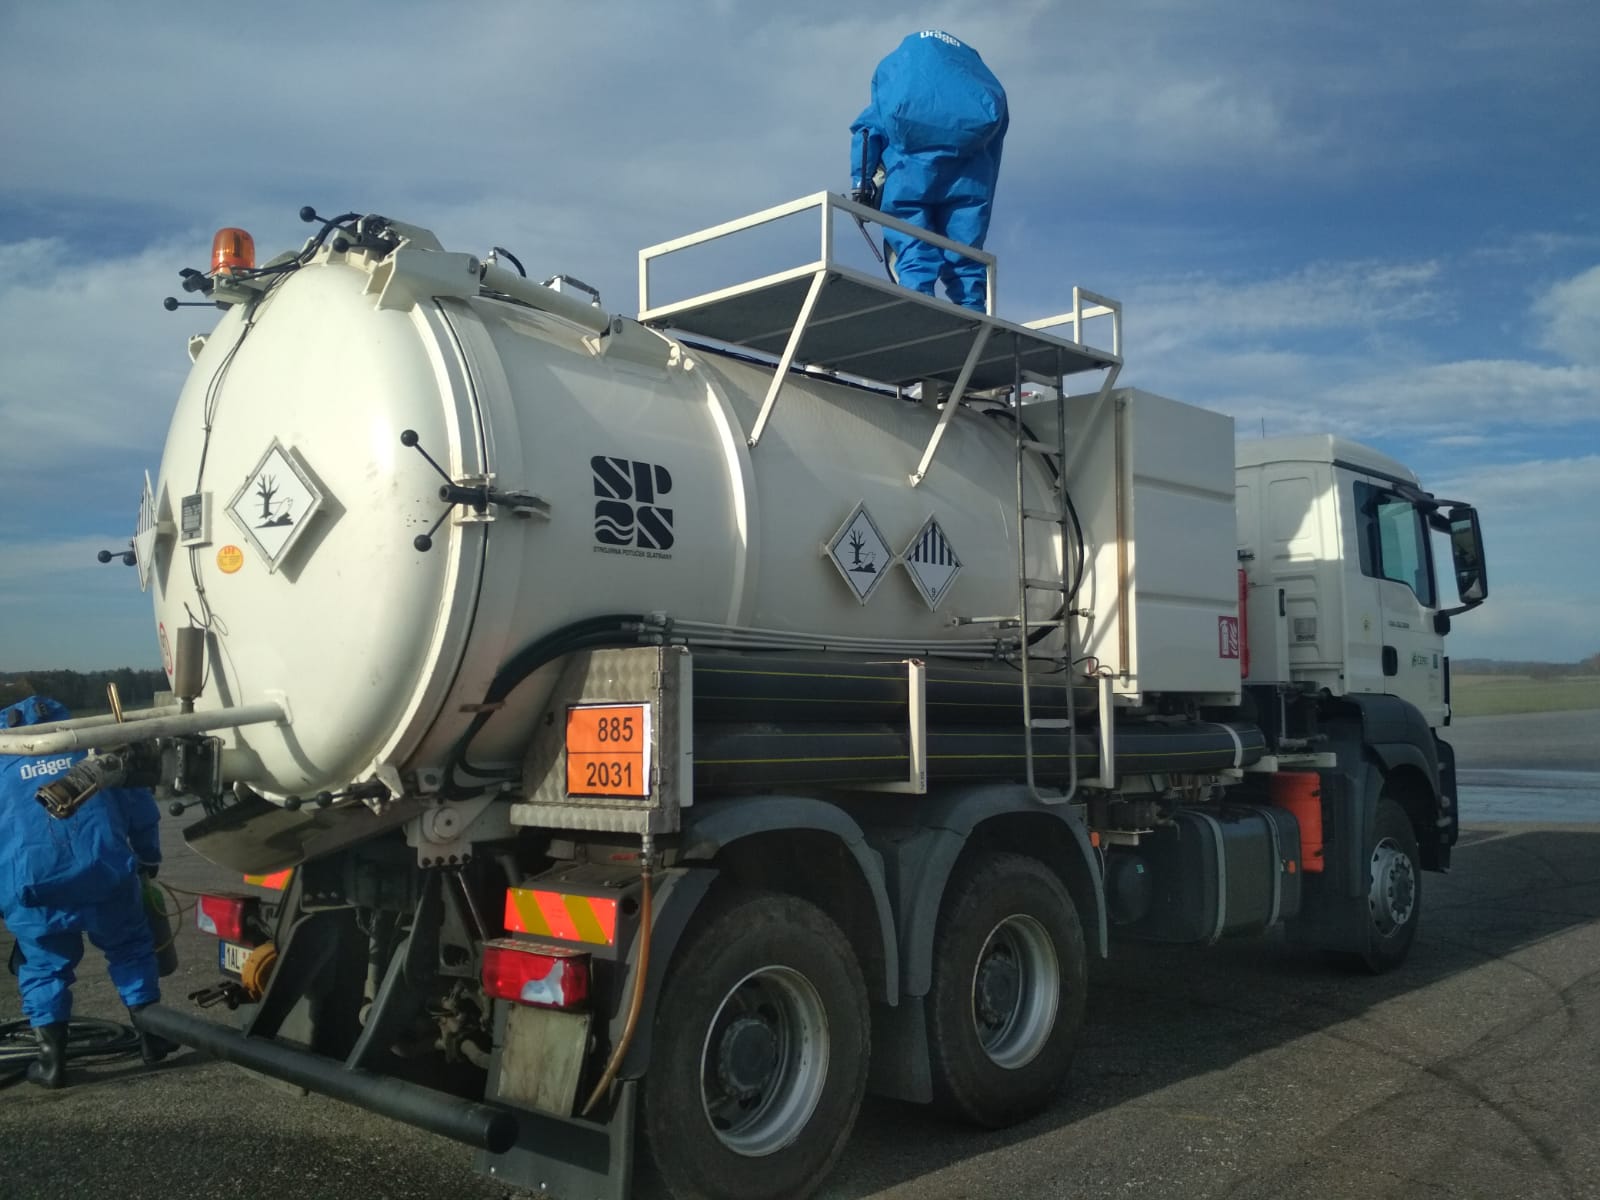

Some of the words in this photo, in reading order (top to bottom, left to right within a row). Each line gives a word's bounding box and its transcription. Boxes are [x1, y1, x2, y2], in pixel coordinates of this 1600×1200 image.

[598, 717, 633, 742] 885
[20, 757, 72, 780] Dräger
[586, 761, 632, 788] 2031
